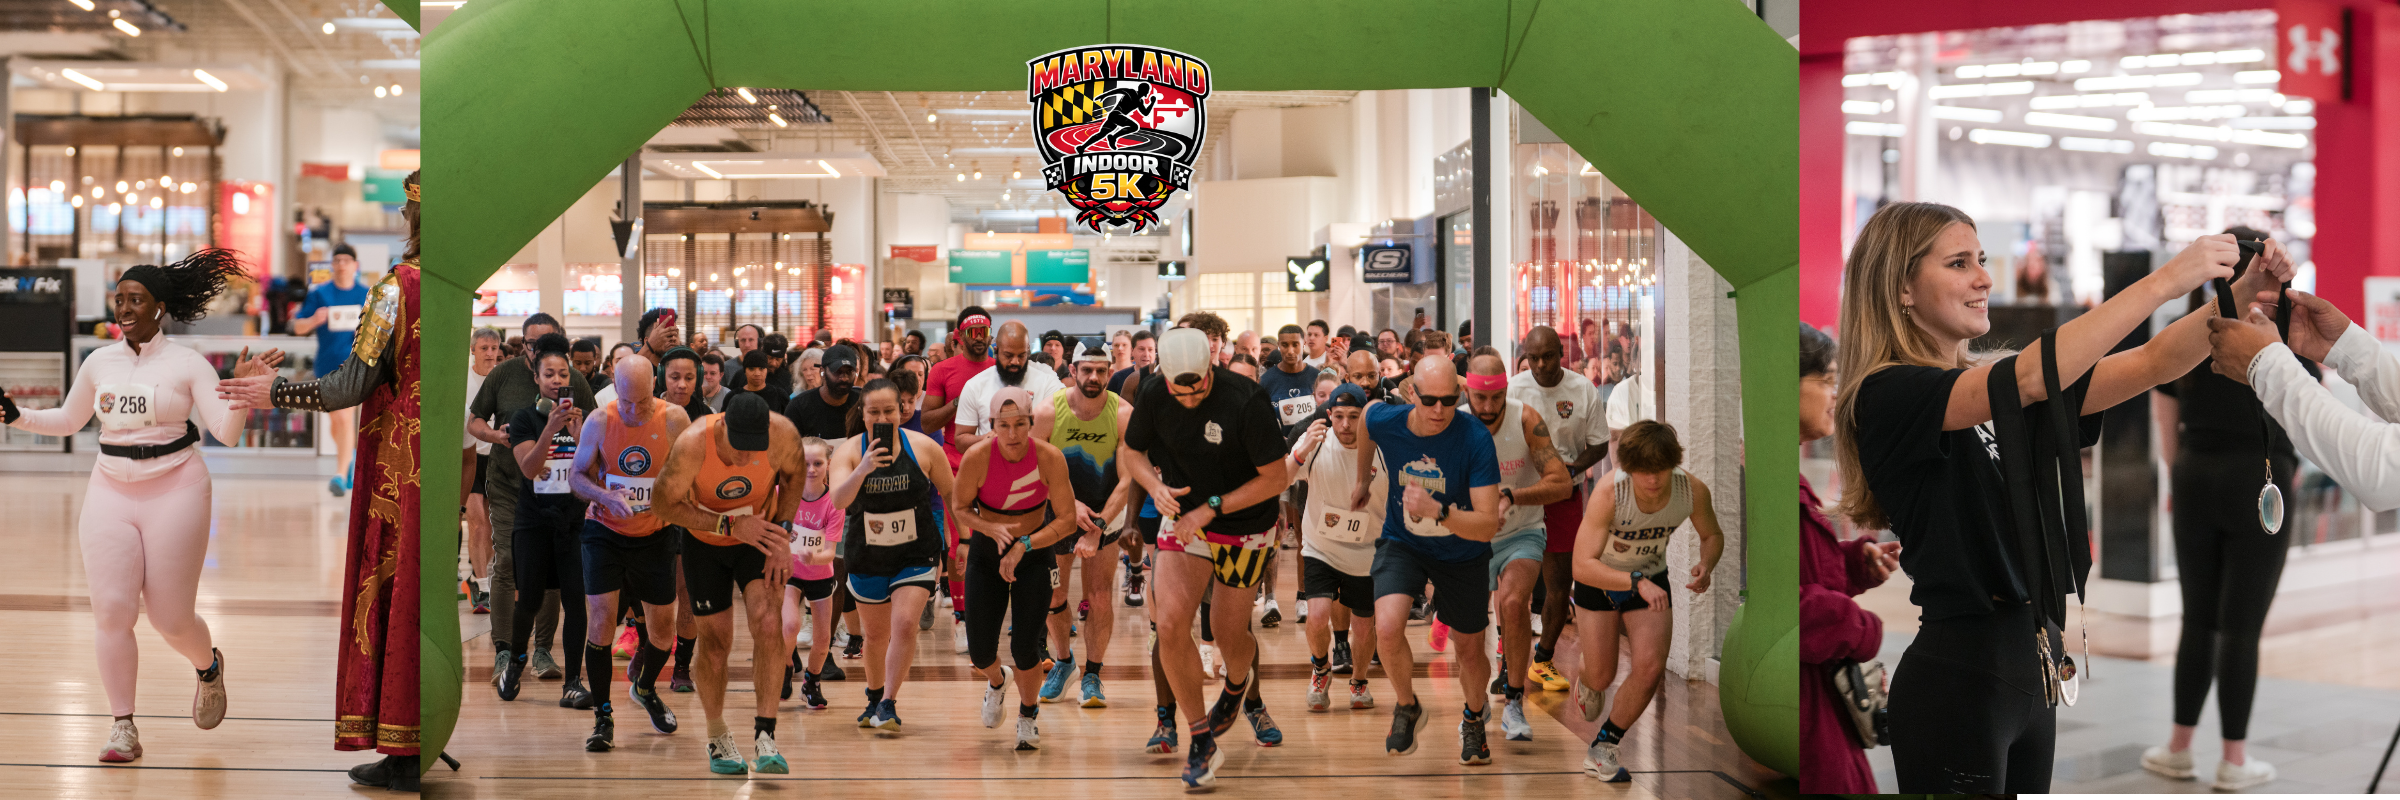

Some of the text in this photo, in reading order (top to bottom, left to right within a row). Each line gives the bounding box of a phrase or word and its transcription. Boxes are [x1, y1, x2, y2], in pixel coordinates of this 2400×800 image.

[120, 396, 147, 414] 258
[1296, 402, 1313, 414] 205
[556, 468, 572, 481] 11
[629, 487, 651, 501] 201
[892, 519, 906, 533] 97
[1347, 519, 1361, 532] 10
[802, 535, 822, 547] 158
[1635, 545, 1659, 556] 194
